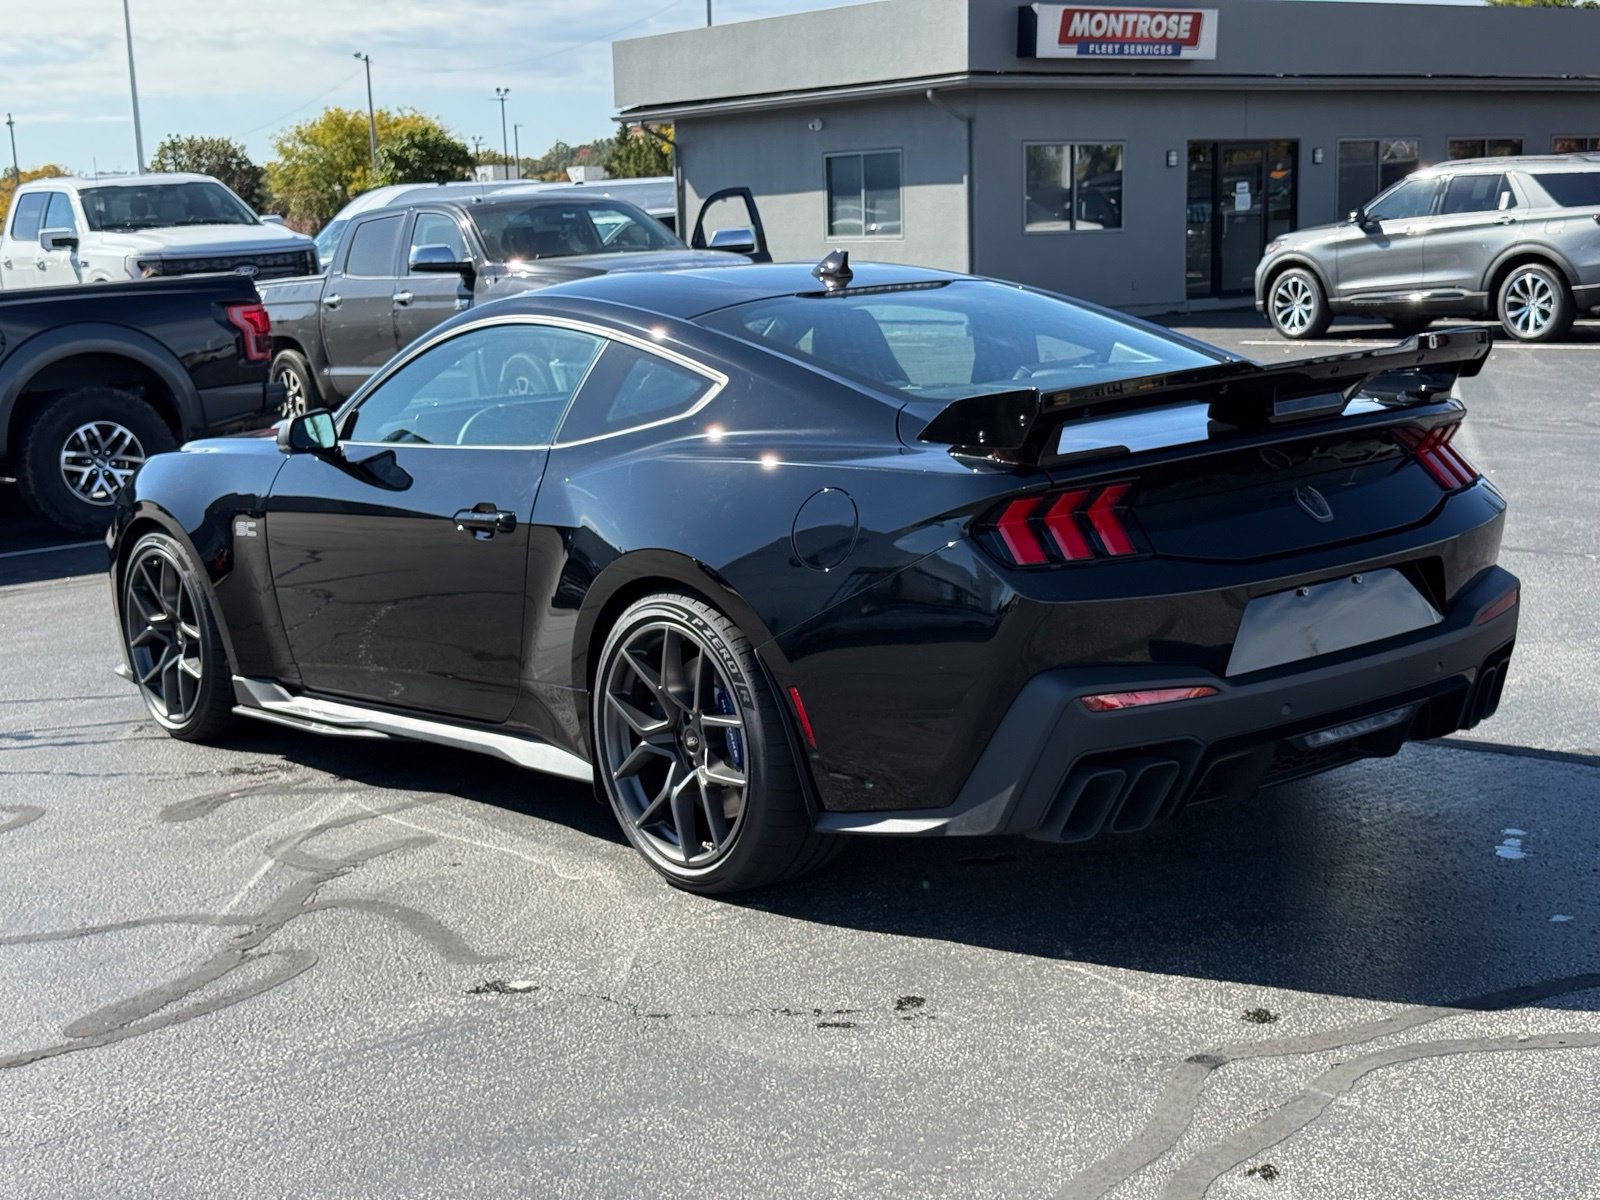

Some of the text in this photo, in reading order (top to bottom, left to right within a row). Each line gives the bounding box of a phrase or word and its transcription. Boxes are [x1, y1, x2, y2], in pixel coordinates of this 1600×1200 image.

[1067, 12, 1193, 39] MONTROSE
[1088, 43, 1173, 55] FLEET SERVICES
[691, 618, 704, 627] P
[702, 627, 739, 676] ZERO
